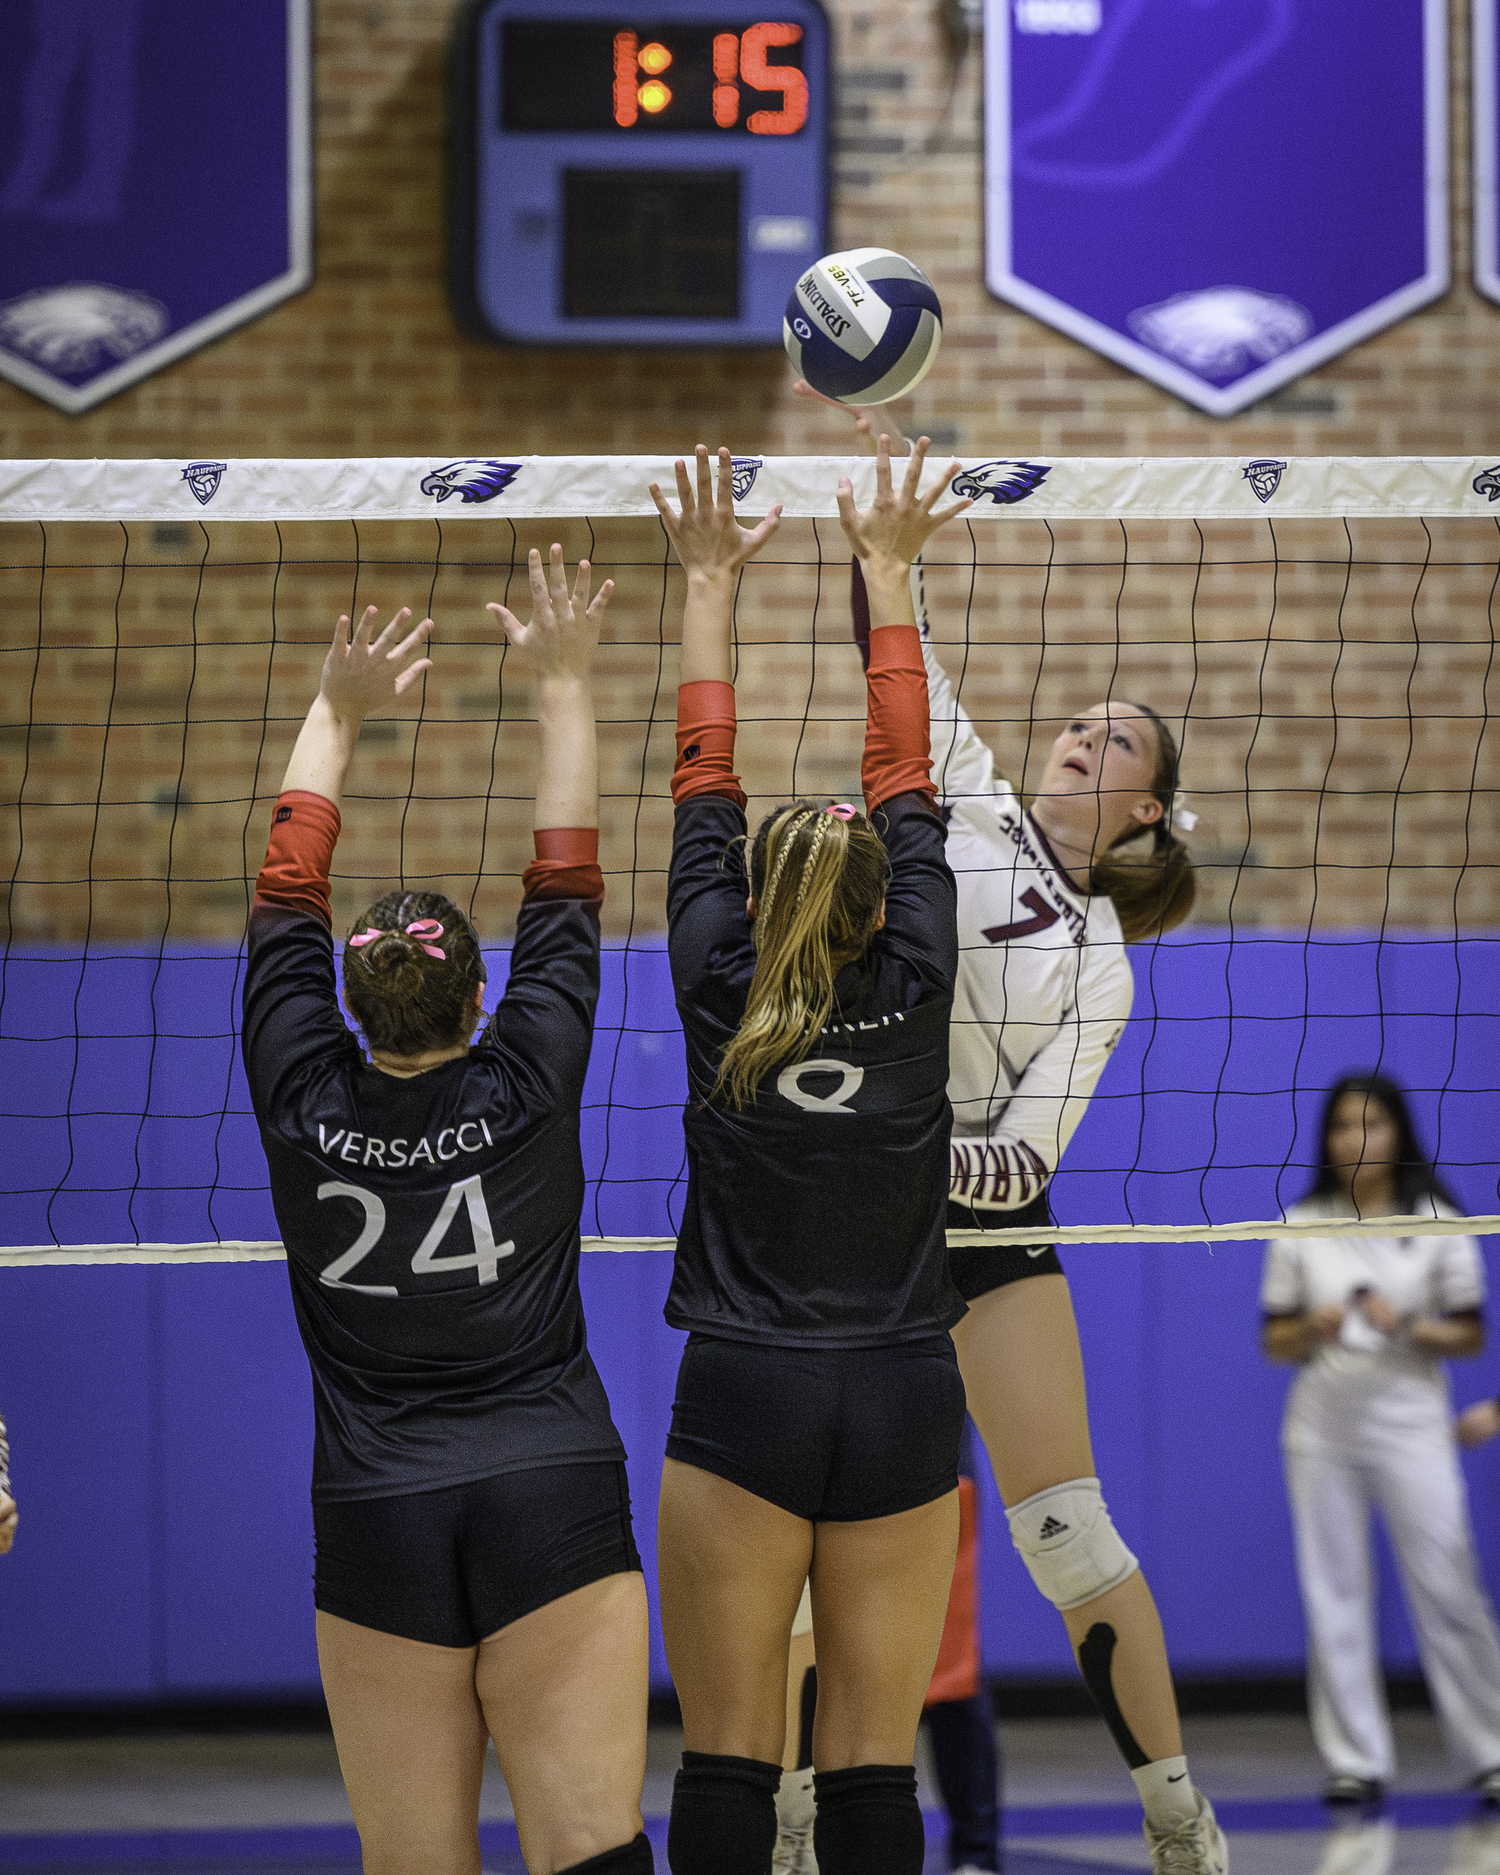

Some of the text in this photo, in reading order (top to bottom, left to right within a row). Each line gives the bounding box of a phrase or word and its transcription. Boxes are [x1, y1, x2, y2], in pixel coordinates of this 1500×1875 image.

[613, 22, 809, 135] 1:15
[799, 273, 851, 338] SPALDING
[981, 886, 1061, 944] 7
[318, 1118, 494, 1168] VERSACCI
[317, 1174, 516, 1297] 24
